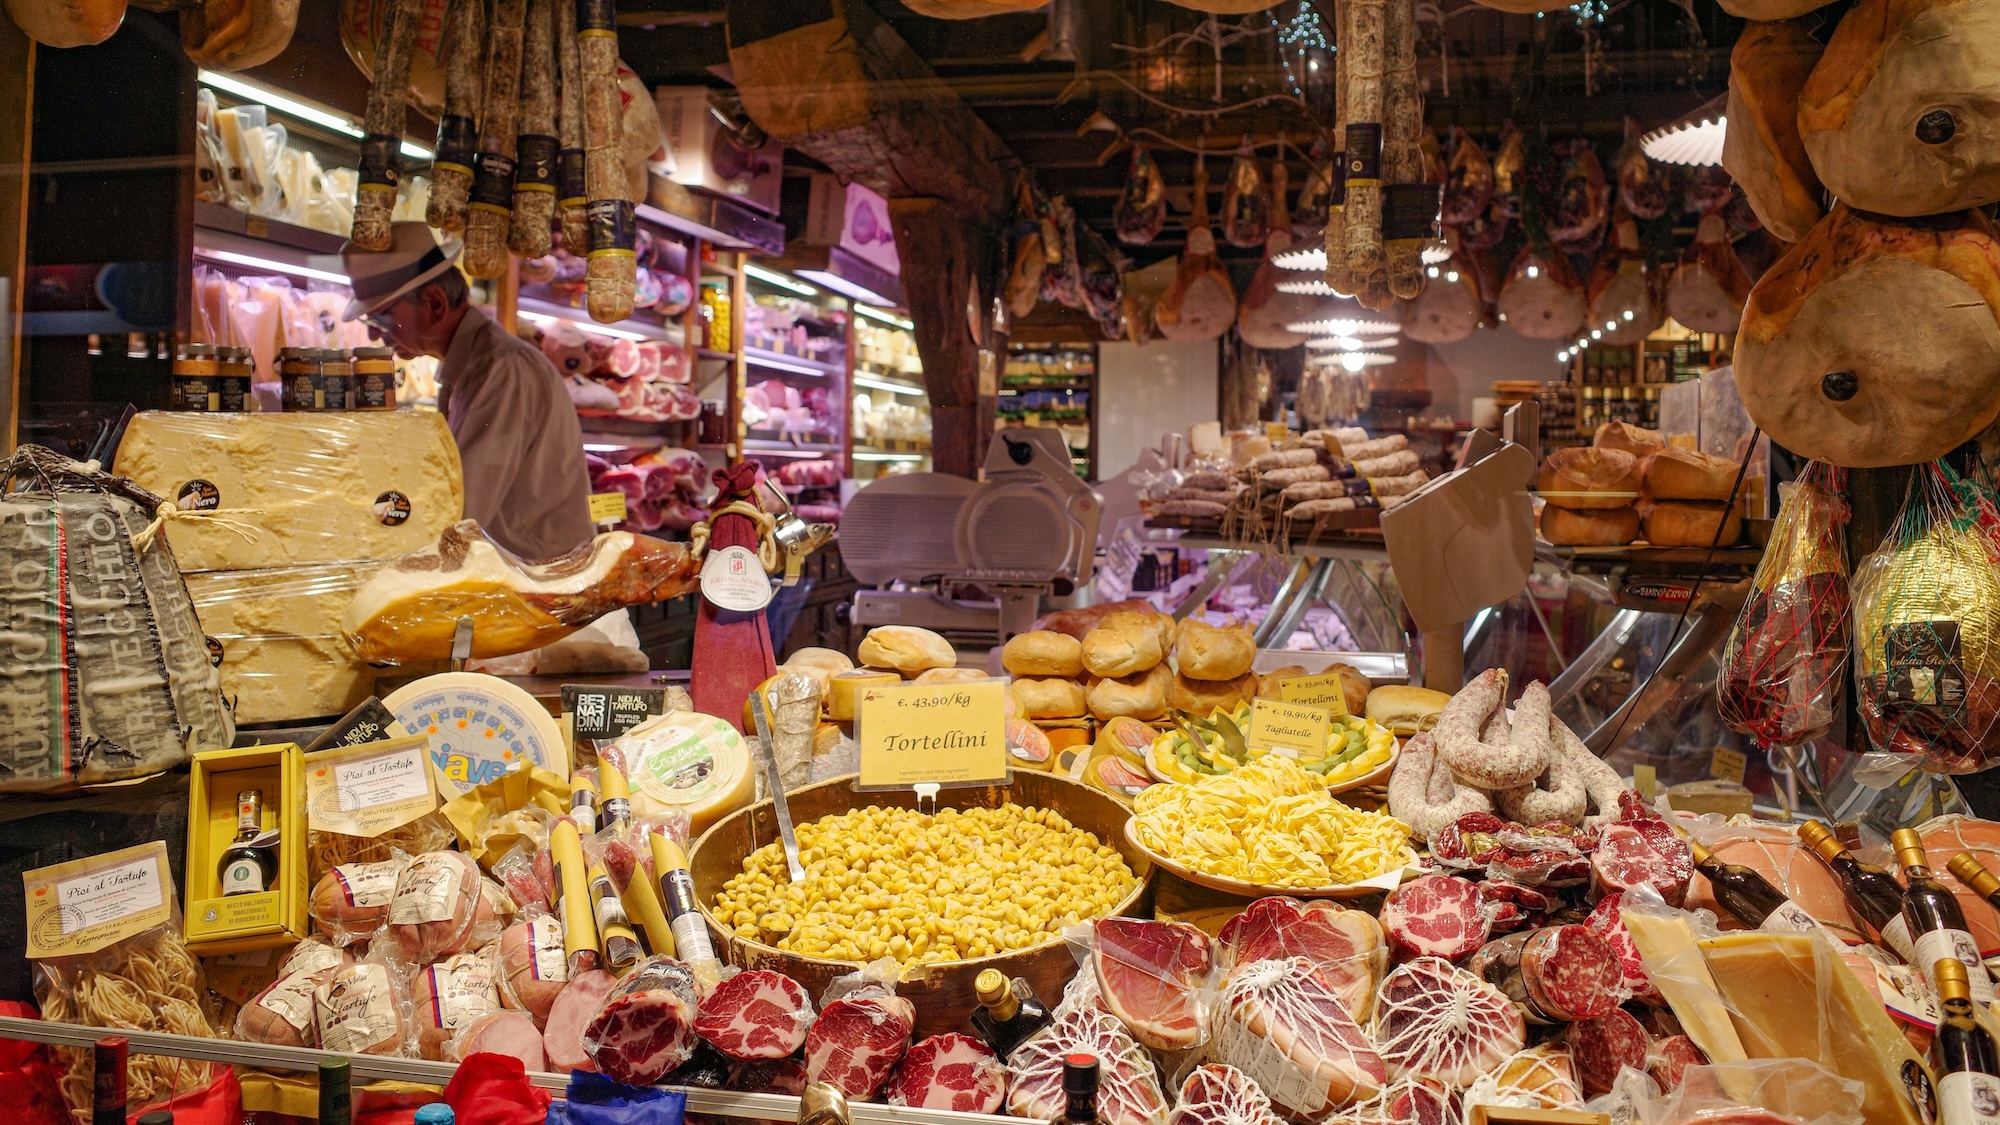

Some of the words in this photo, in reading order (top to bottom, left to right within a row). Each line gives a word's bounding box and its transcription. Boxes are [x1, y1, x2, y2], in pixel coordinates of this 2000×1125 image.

[193, 497, 216, 507] Nero
[578, 694, 606, 706] BER
[612, 702, 648, 711] TARTUFO
[912, 692, 971, 708] 43,90/kg
[577, 705, 605, 717] NAR
[1283, 710, 1322, 723] 19,90/kg
[576, 716, 605, 728] DINI
[1265, 724, 1312, 738] Tagliatelle
[883, 730, 987, 751] Tortellini
[343, 770, 364, 781] Pici
[367, 765, 377, 776] al
[379, 757, 414, 773] Tartufo
[67, 884, 91, 899] Pici
[94, 879, 106, 891] al
[108, 868, 148, 886] Tartufo
[464, 976, 494, 998] tartufo
[338, 985, 378, 1018] tartufo
